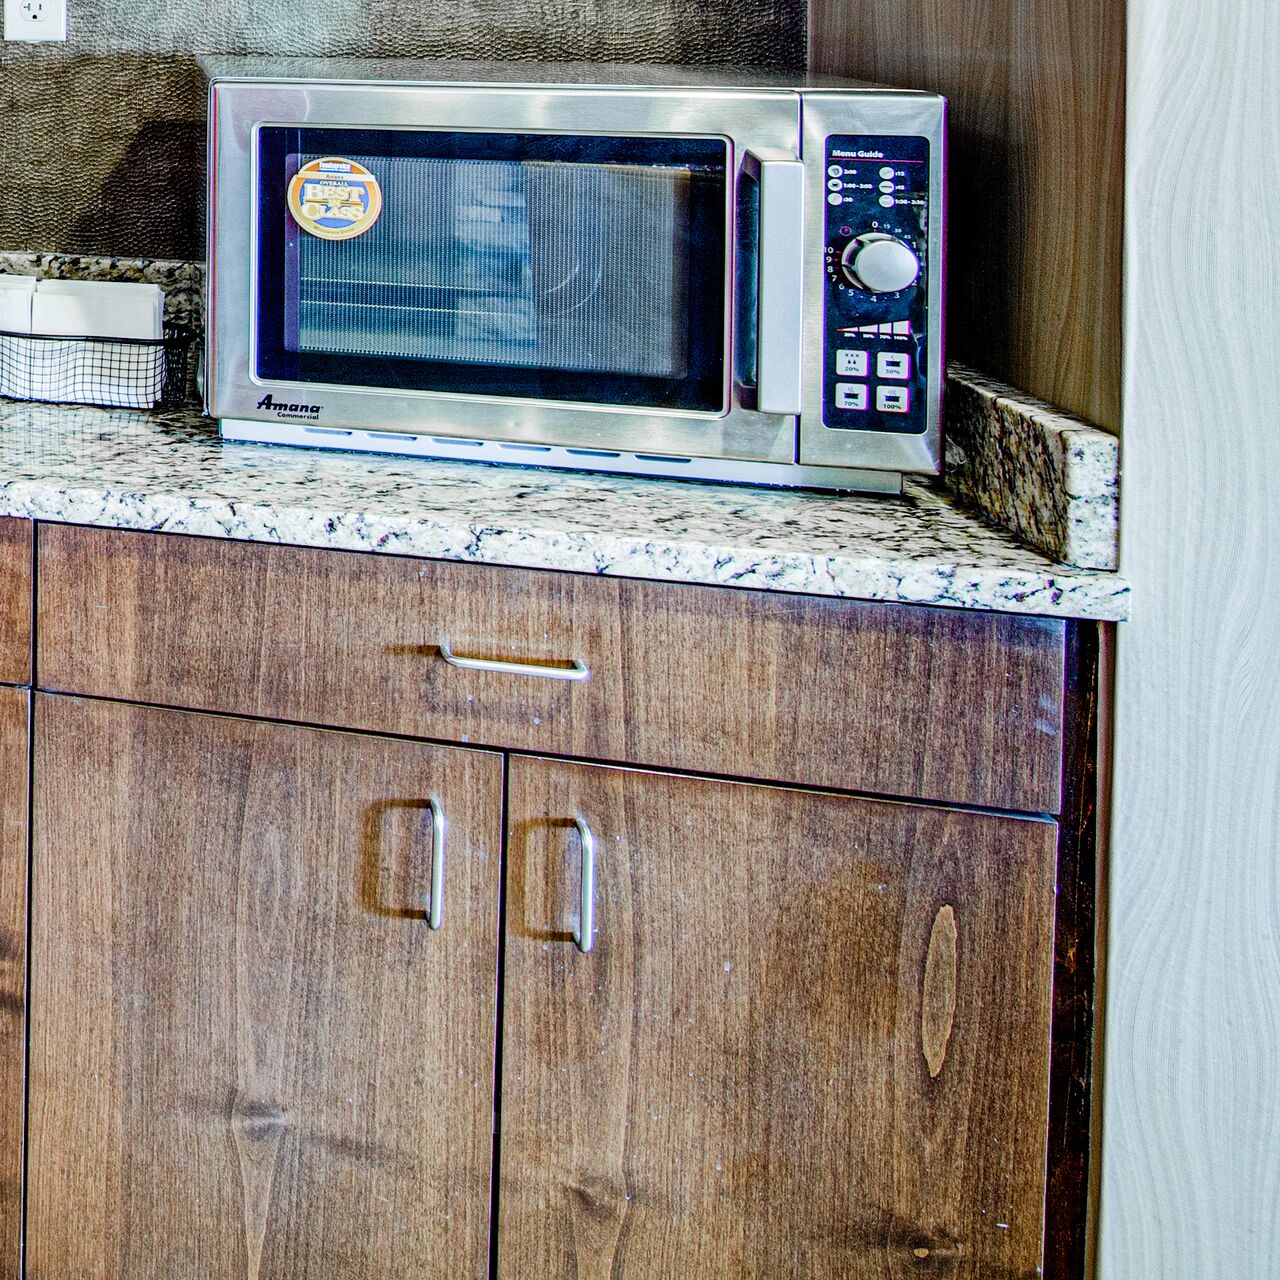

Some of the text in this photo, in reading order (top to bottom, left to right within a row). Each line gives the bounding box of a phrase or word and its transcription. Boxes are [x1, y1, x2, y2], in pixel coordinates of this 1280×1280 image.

[832, 149, 884, 158] Menu Guide
[303, 183, 366, 201] BEST
[300, 202, 365, 220] CLASS
[848, 289, 855, 297] 5
[893, 291, 900, 299] 3
[870, 295, 878, 303] 4
[256, 393, 320, 413] Amana
[276, 411, 319, 420] Commercial
